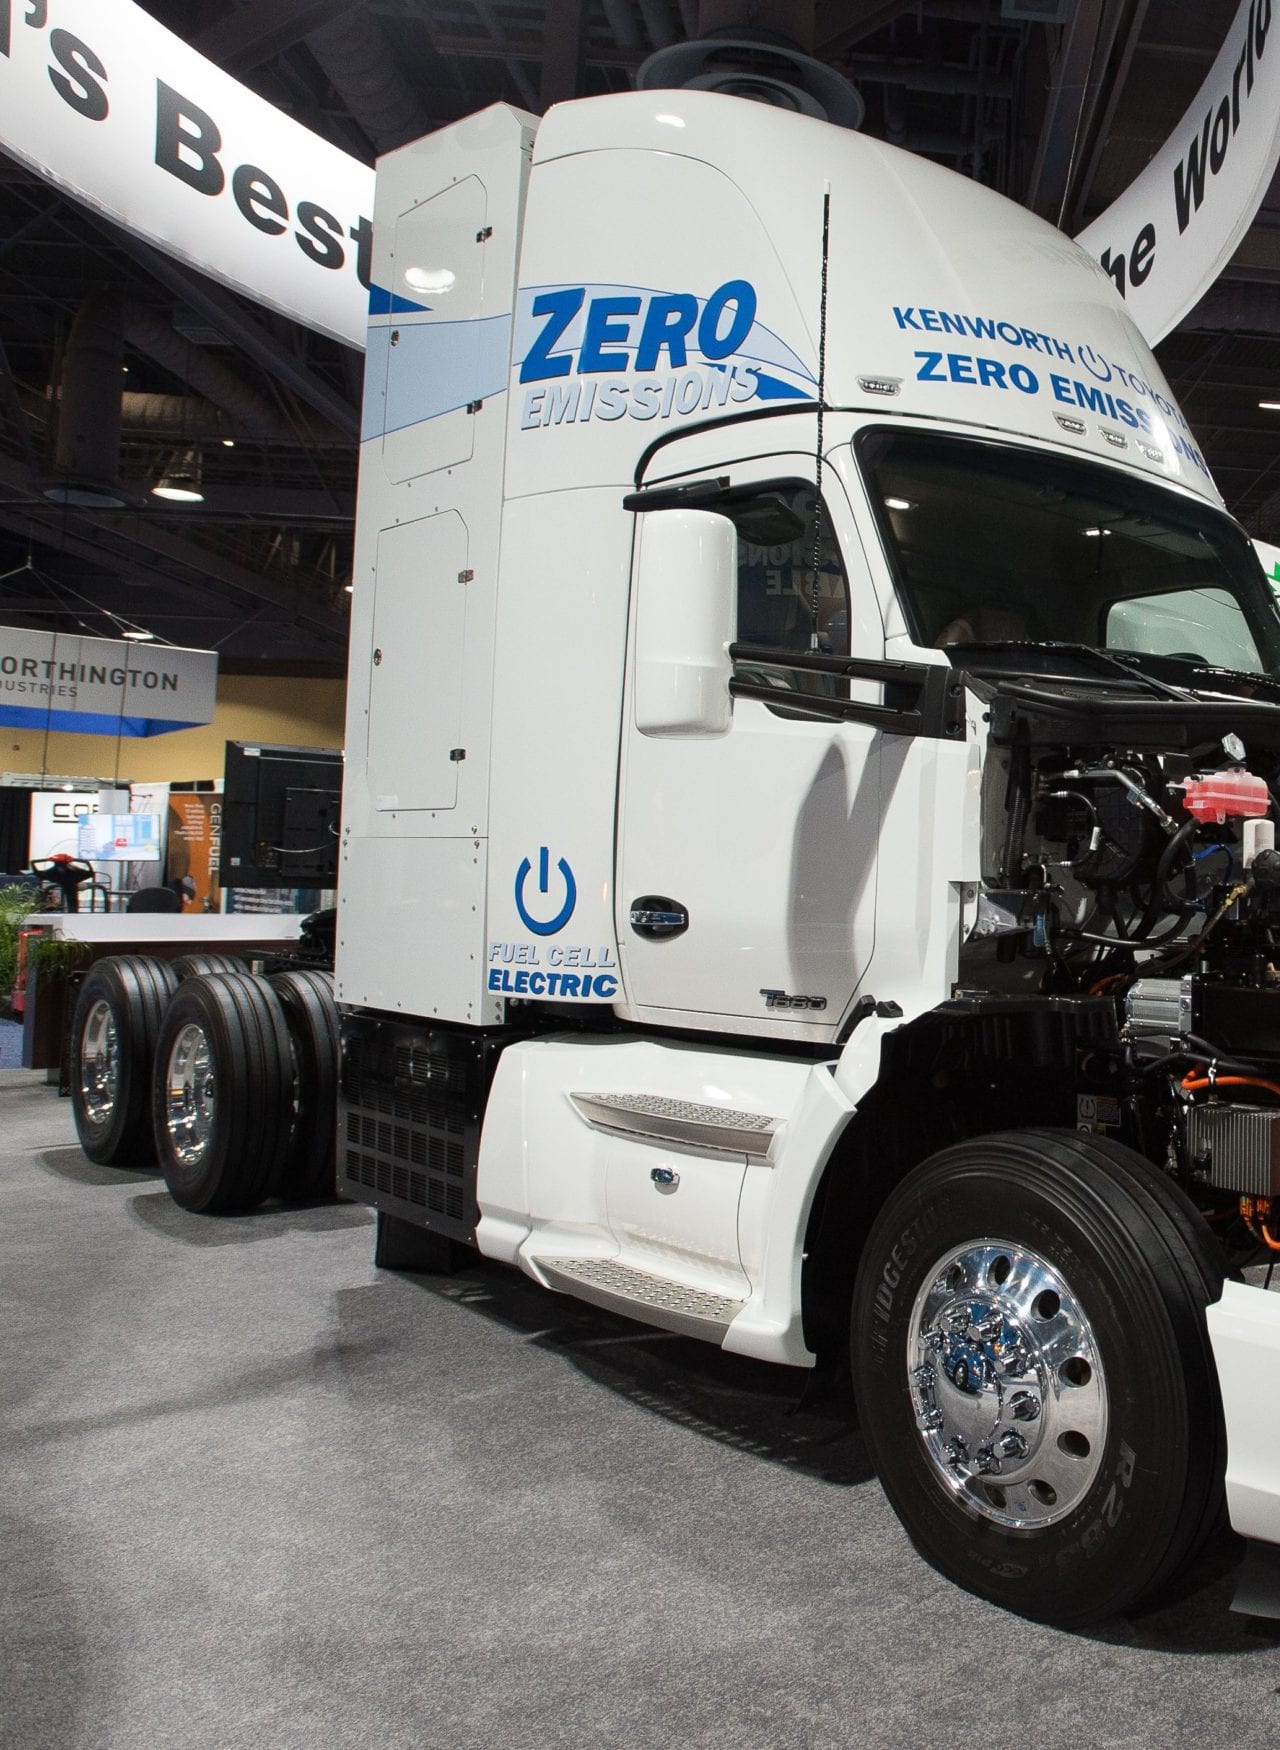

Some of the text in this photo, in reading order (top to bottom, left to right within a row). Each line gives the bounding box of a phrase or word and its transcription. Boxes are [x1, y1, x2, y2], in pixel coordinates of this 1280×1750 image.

[155, 77, 373, 291] Best
[519, 279, 757, 384] ZERO
[520, 360, 763, 431] EMISSIONS
[892, 306, 1188, 431] KENWORTH TOYOTA
[914, 351, 1210, 479] ZERO EMISSONS
[208, 803, 222, 875] GENFUEL
[488, 942, 616, 968] FUEL CELL
[488, 968, 618, 997] ELECTRIC
[759, 988, 827, 1011] T680
